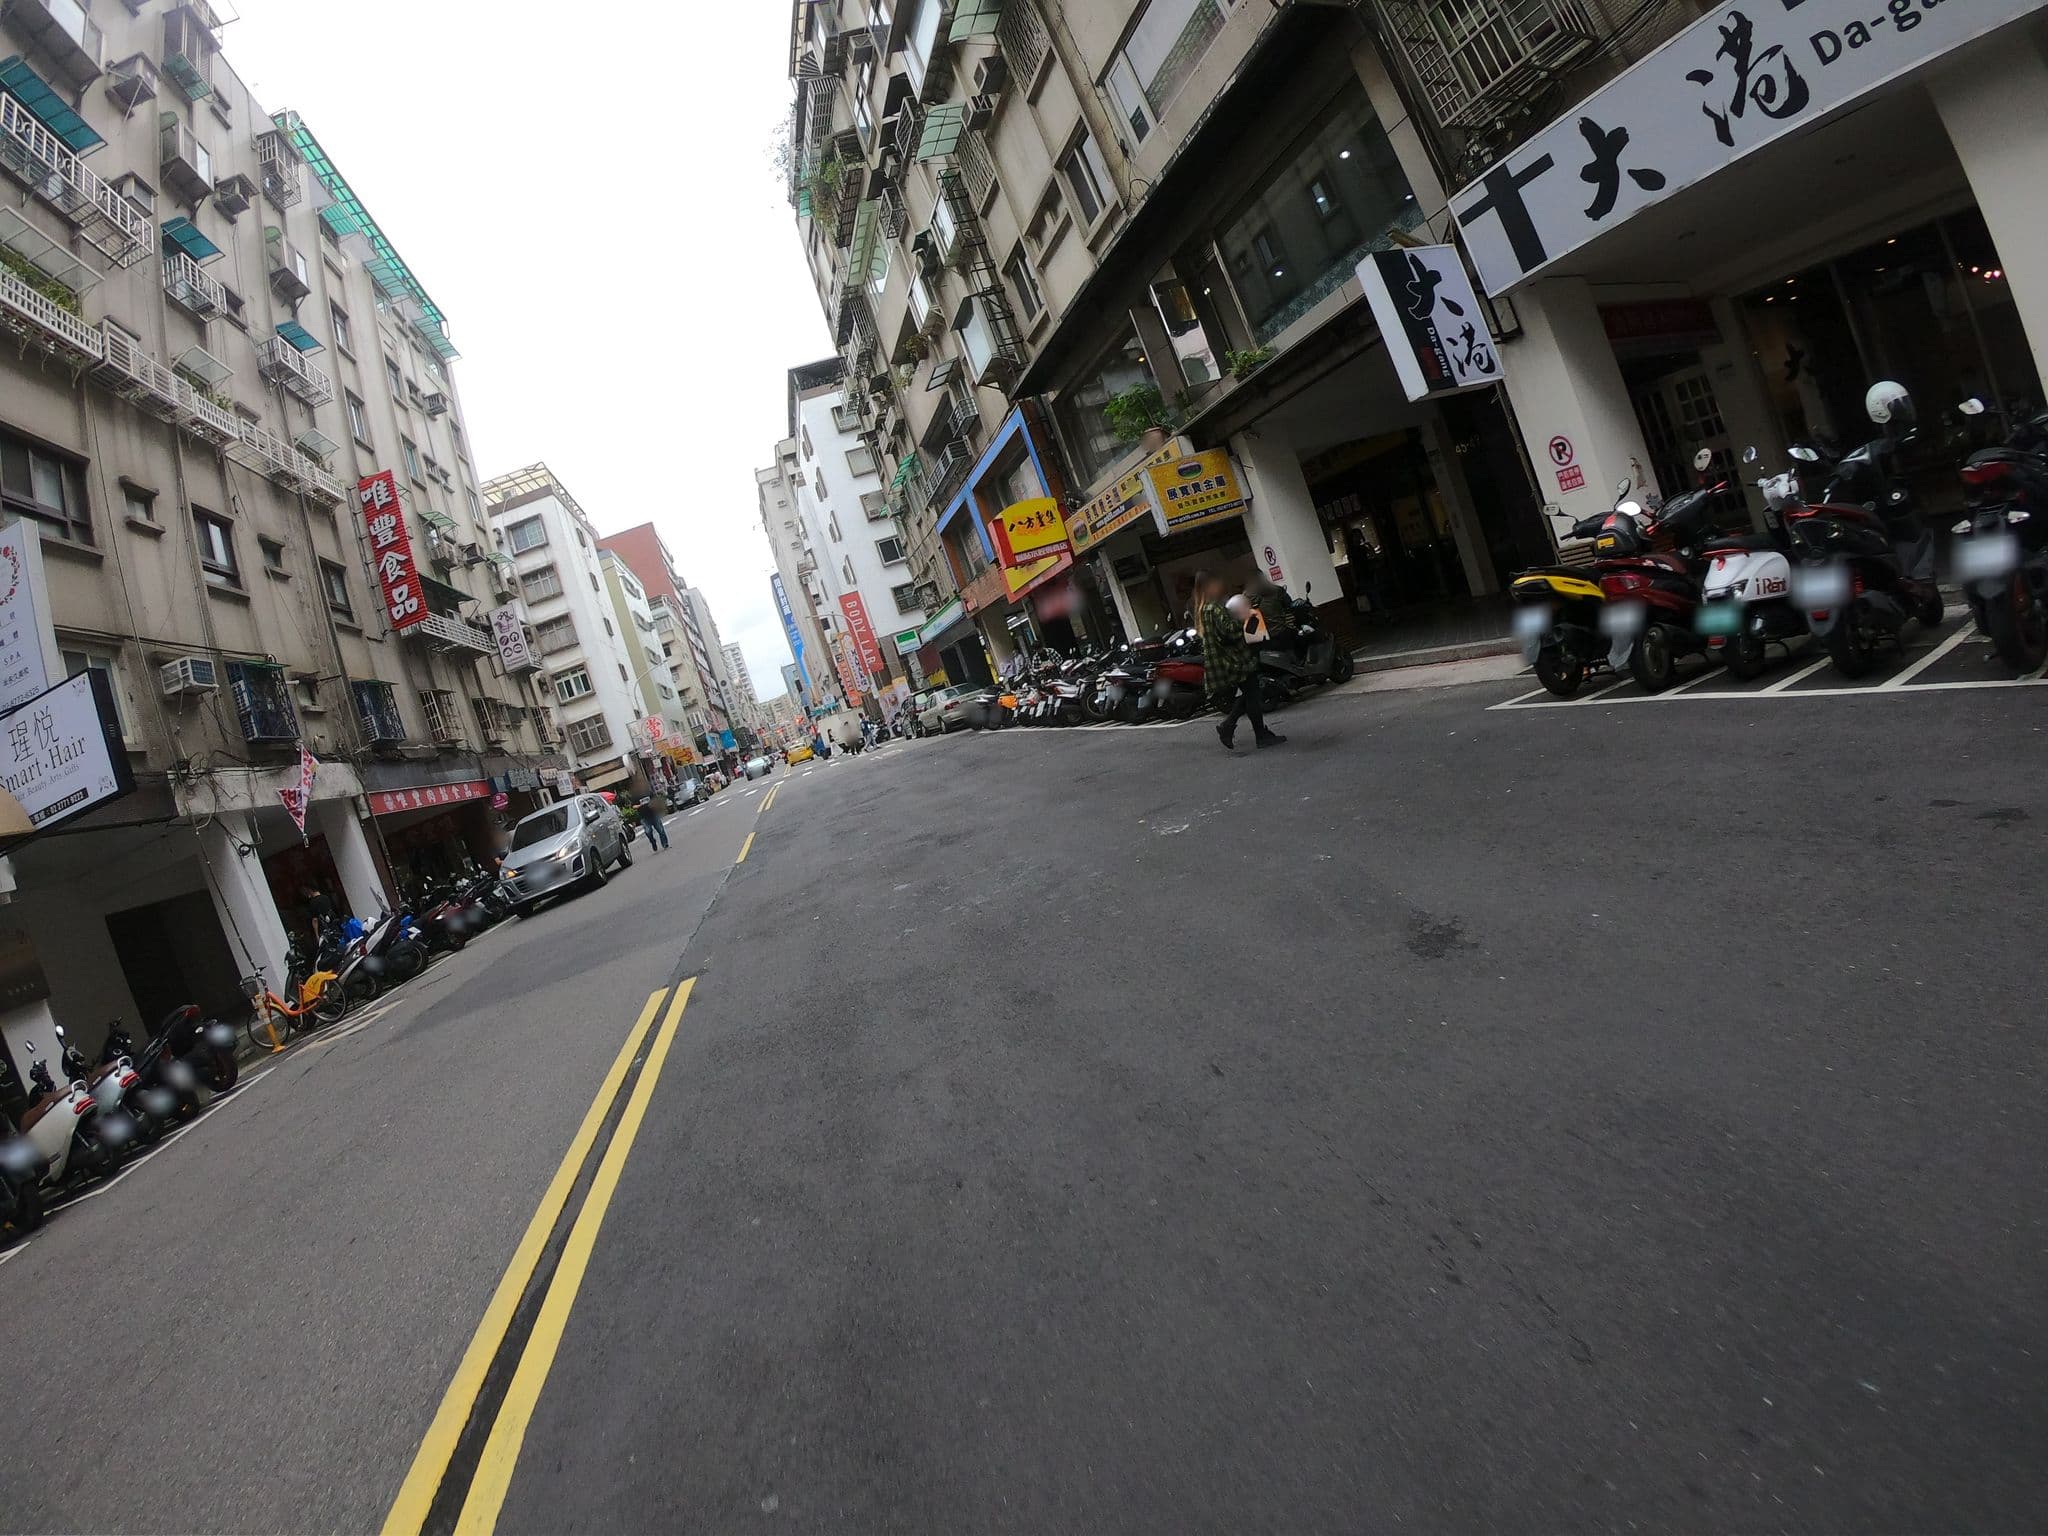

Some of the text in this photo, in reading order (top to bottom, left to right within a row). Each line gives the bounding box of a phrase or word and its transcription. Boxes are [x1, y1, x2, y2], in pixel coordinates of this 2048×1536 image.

[1427, 326, 1452, 378] Da-gang
[360, 479, 419, 621] 唯豐食品
